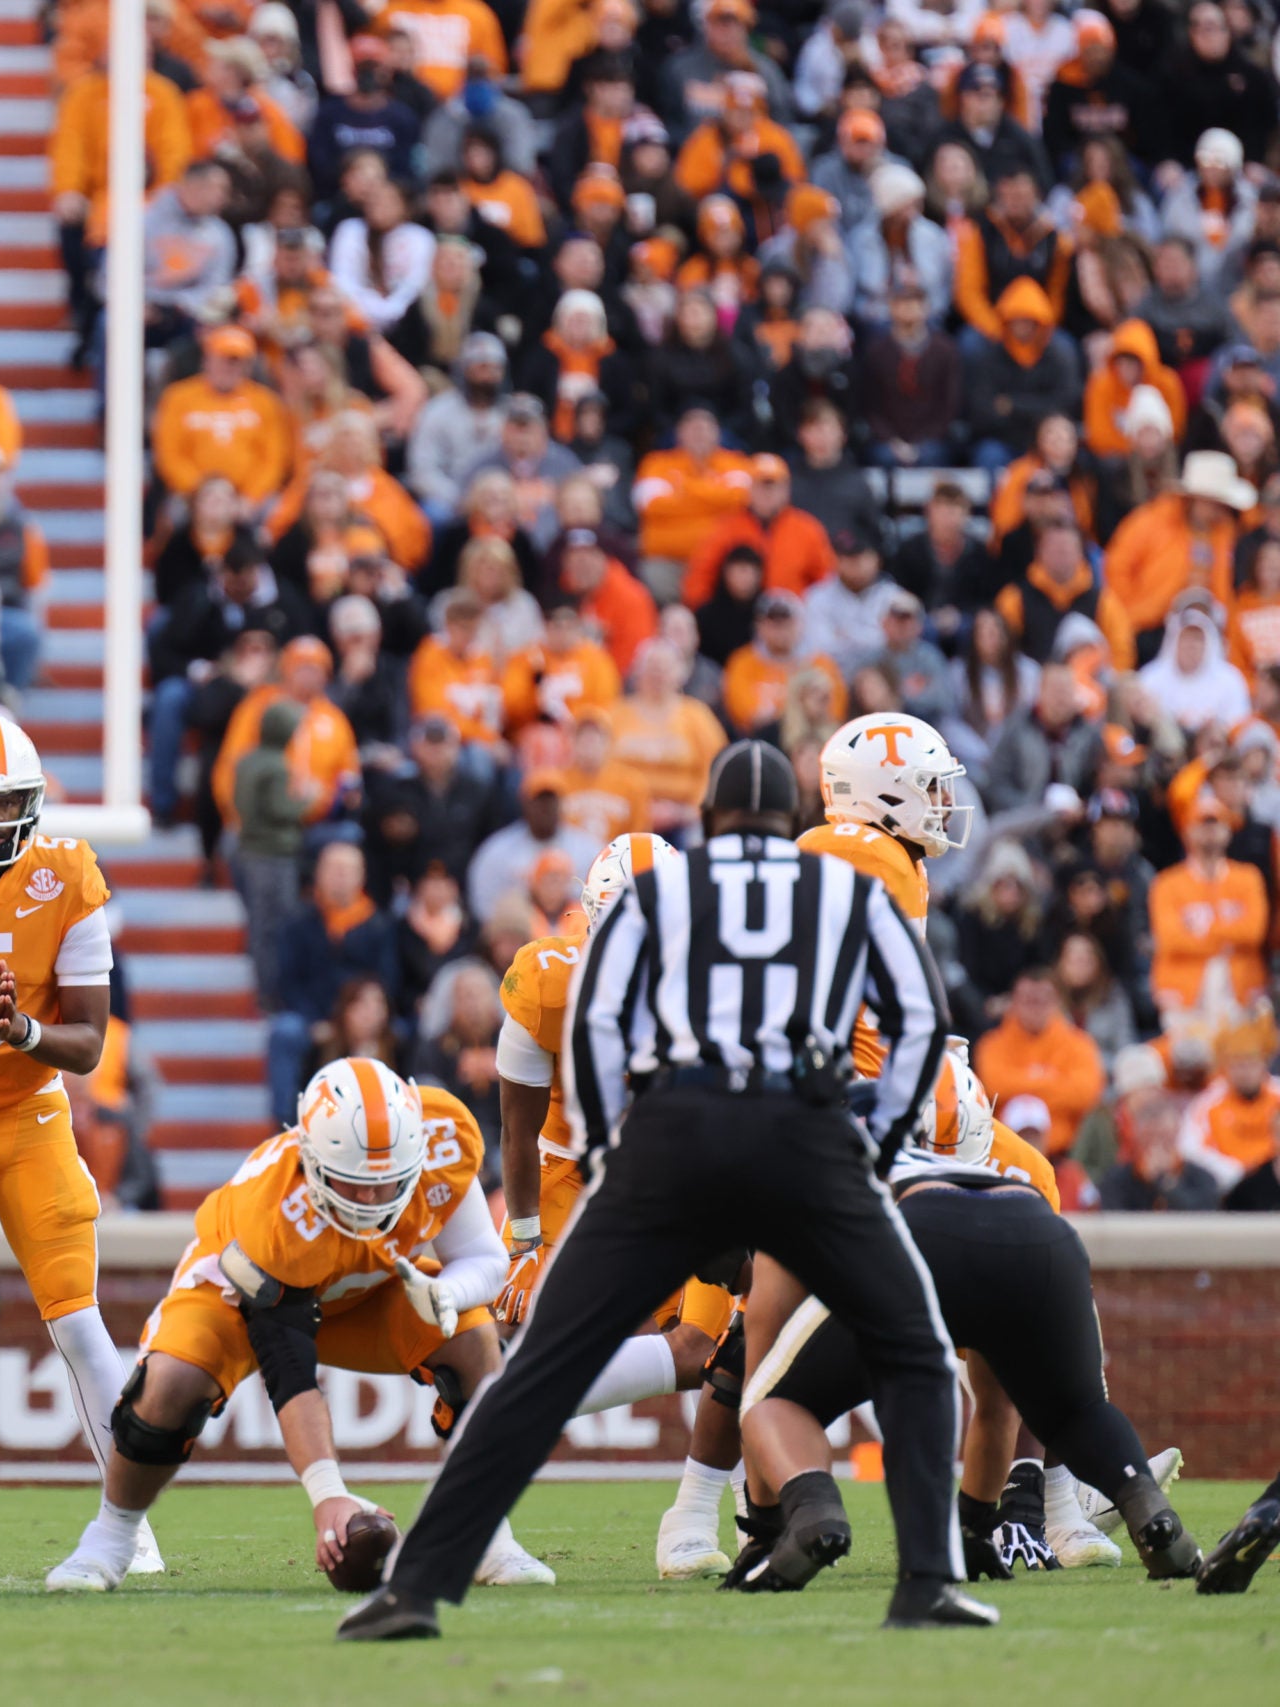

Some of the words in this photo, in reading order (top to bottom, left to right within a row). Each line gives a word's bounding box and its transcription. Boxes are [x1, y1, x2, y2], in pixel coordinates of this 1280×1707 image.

[865, 725, 913, 767] T
[31, 867, 56, 891] SEC
[709, 861, 801, 959] U
[302, 1078, 339, 1134] T
[422, 1117, 462, 1172] 63
[426, 1183, 452, 1207] SEC
[383, 1238, 400, 1260] T
